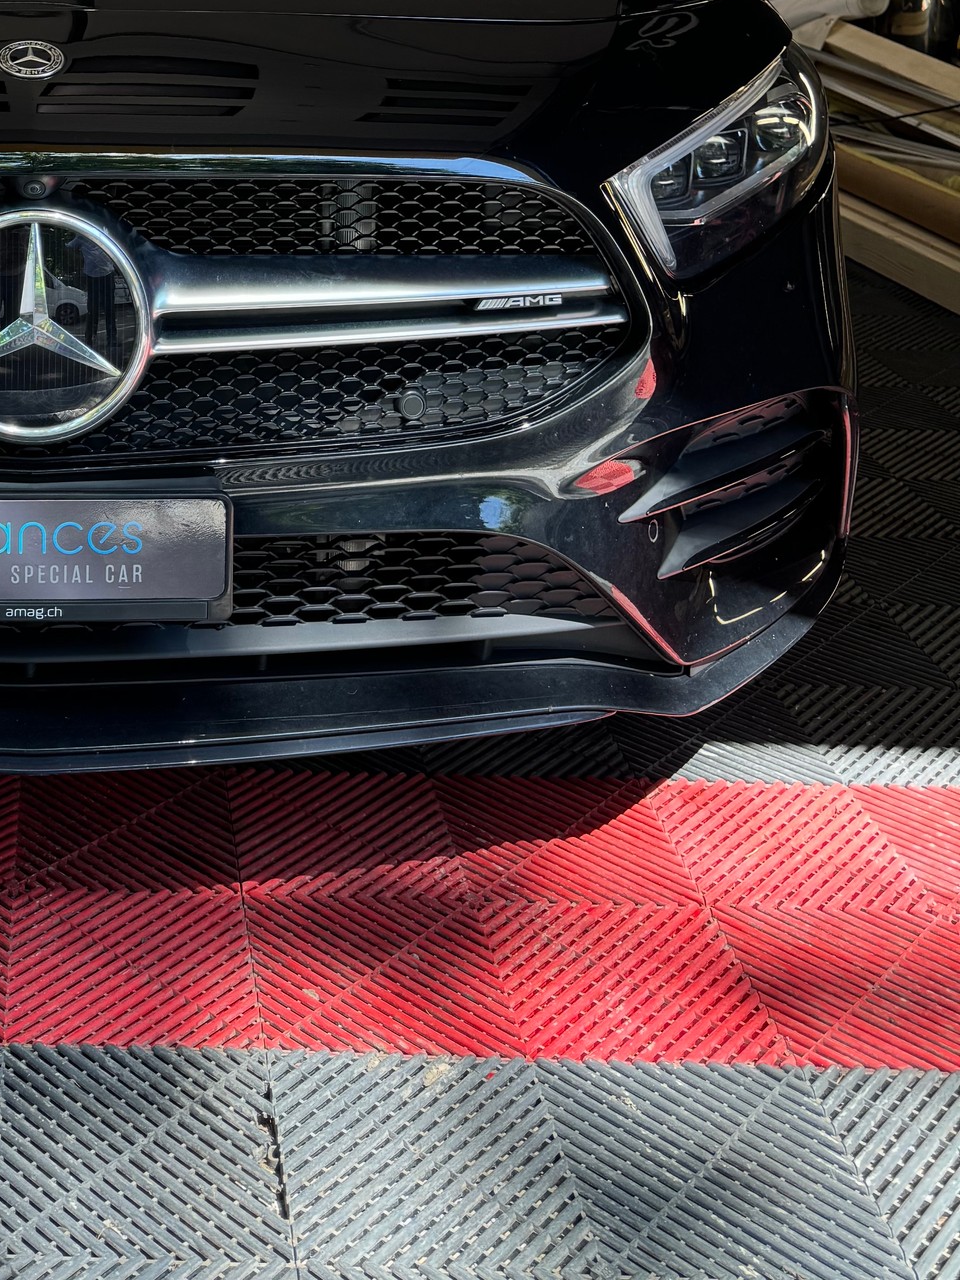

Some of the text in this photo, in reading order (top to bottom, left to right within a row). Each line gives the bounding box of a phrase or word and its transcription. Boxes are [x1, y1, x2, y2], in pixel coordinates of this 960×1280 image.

[10, 563, 144, 585] SPECIAL CAR
[5, 605, 63, 620] amag.ch
